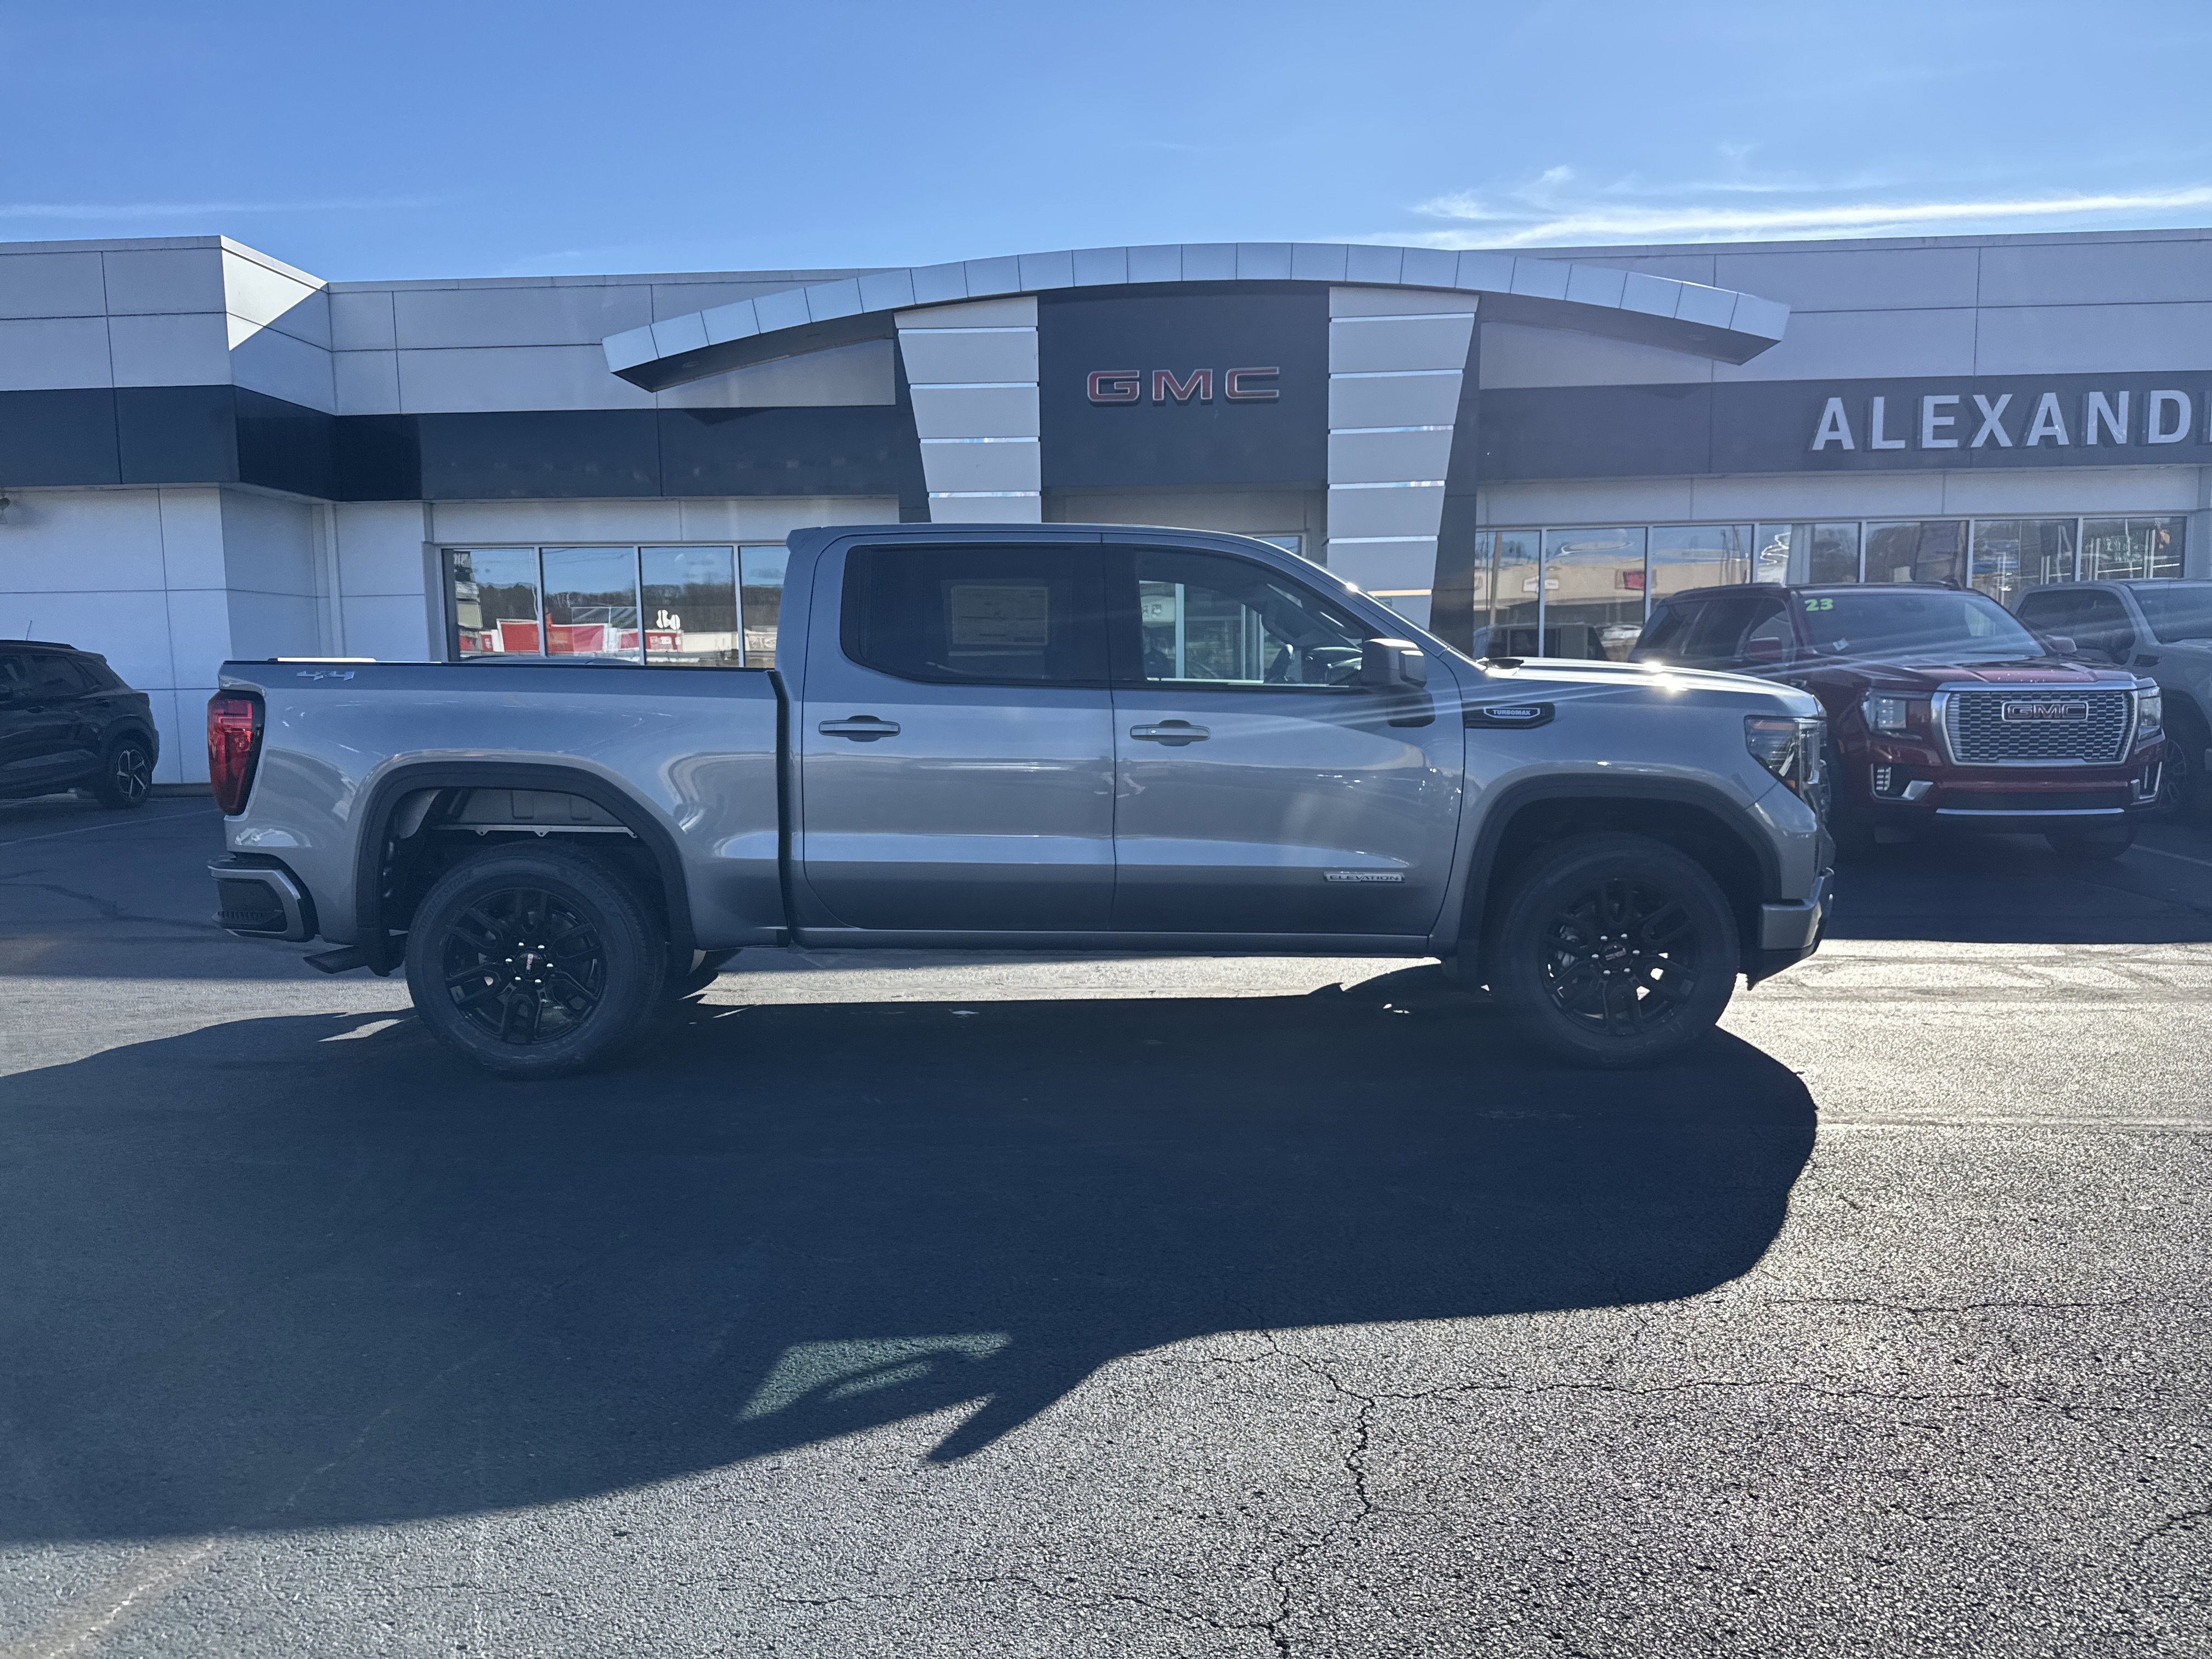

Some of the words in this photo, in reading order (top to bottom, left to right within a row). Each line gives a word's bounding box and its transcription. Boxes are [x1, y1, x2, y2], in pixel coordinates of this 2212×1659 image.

[1087, 366, 1280, 402] GMC
[1812, 388, 2212, 450] ALEXAND
[1804, 598, 1834, 612] 23
[2007, 704, 2085, 719] GMC
